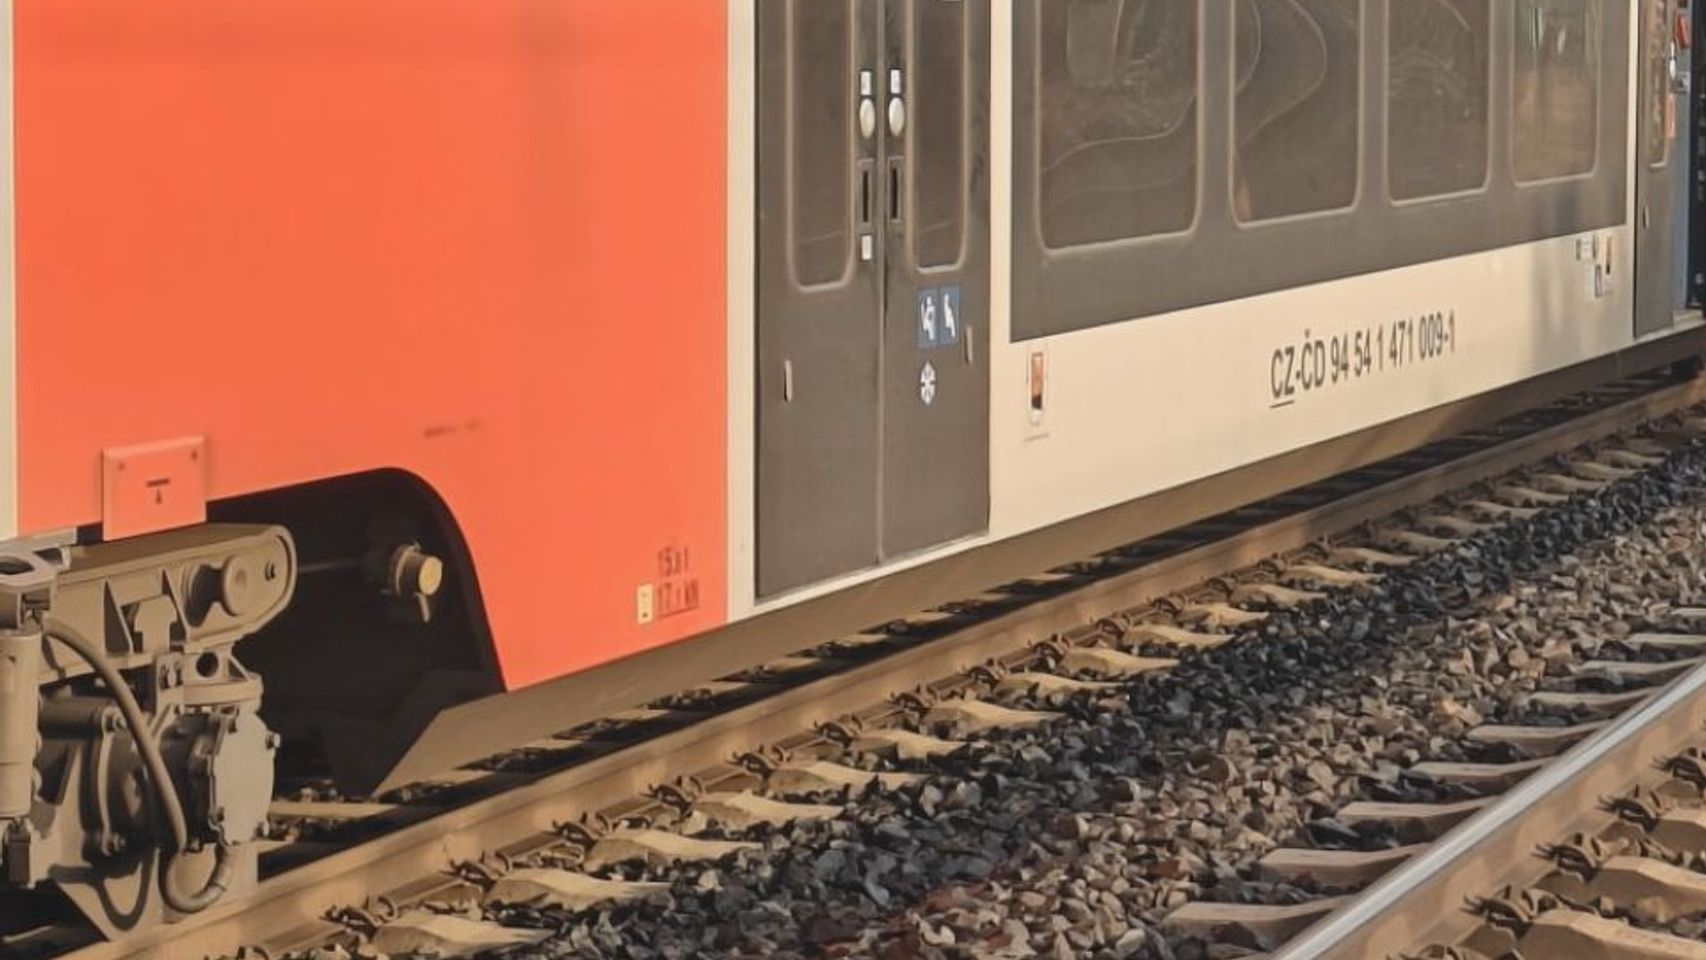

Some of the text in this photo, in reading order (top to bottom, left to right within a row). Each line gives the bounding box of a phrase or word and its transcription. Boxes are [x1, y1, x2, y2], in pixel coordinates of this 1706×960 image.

[1330, 334, 1349, 383] 94
[1354, 328, 1372, 378] 54
[1376, 324, 1384, 372] 1
[1388, 317, 1413, 368] 471
[1418, 309, 1456, 361] 009-1
